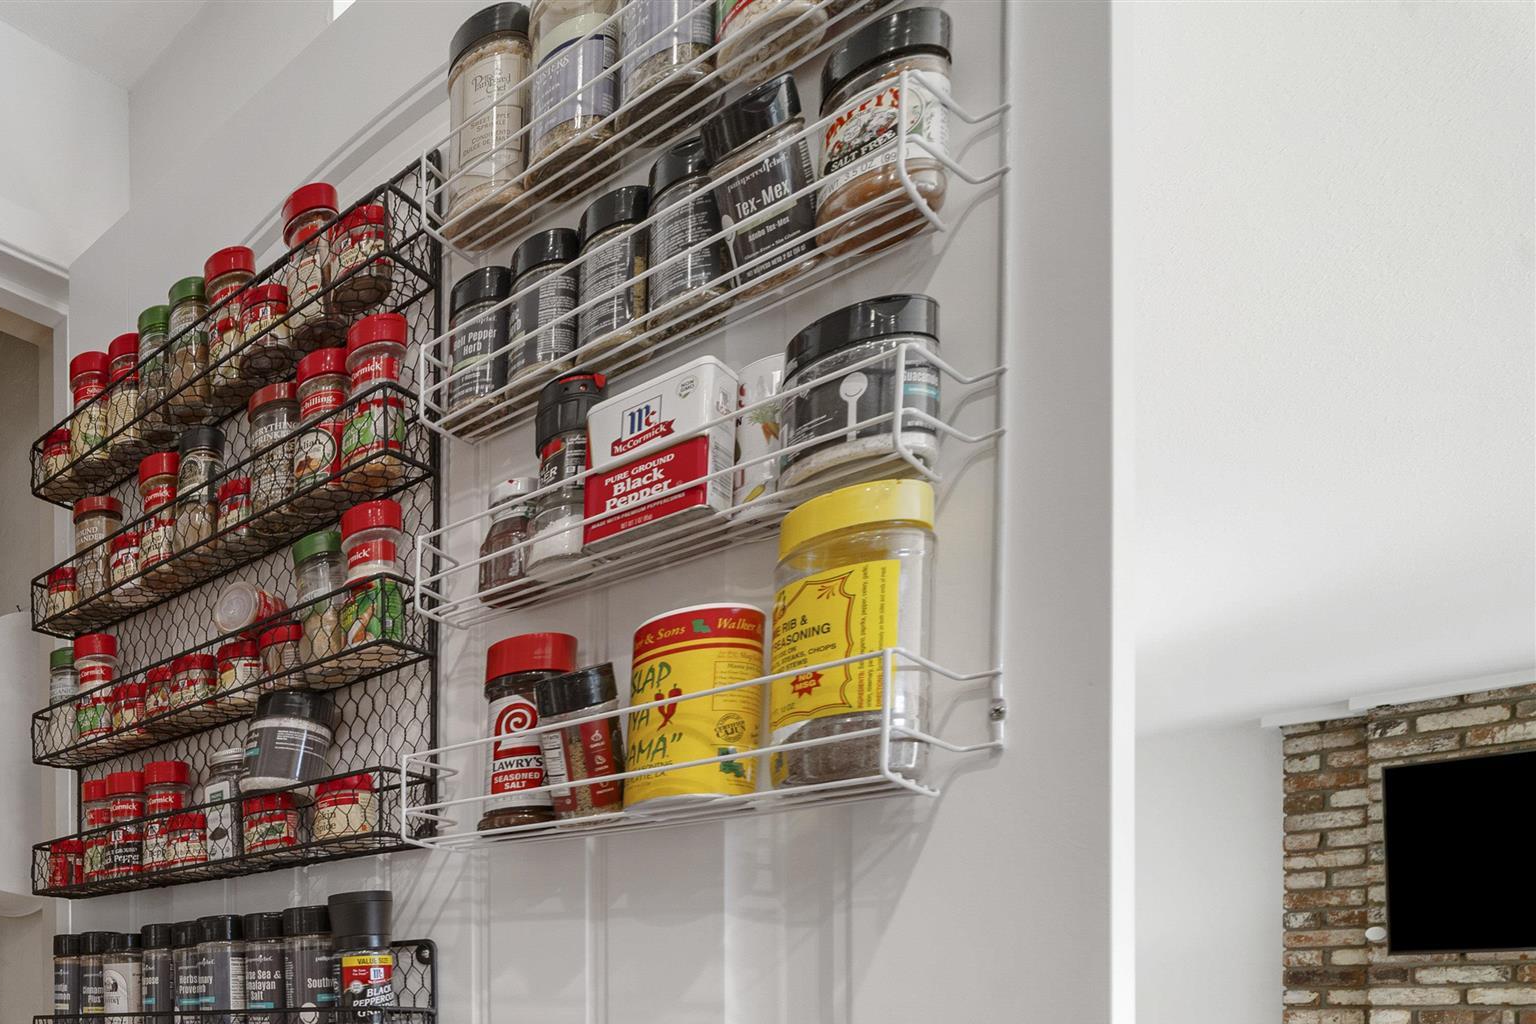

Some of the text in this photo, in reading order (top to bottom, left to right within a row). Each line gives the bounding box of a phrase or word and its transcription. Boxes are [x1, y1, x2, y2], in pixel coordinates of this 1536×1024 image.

[831, 152, 860, 173] SALT
[735, 179, 790, 220] Tex-Mex
[468, 329, 496, 342] Pepper
[613, 422, 667, 455] McCormick
[605, 453, 675, 487] PURE GROUND
[613, 468, 664, 497] Black
[606, 478, 673, 512] Pepper
[716, 617, 755, 631] Walker
[783, 615, 808, 630] RIB &
[657, 626, 686, 641] Sons
[808, 643, 836, 654] CHOPS
[799, 672, 813, 681] NO
[795, 680, 816, 690] MSG
[492, 756, 543, 772] LAWRY'S
[494, 772, 541, 784] SEASONED
[504, 781, 527, 790] SALT
[257, 970, 272, 979] Sea
[250, 991, 264, 1001] Salt
[366, 985, 392, 998] BLACK
